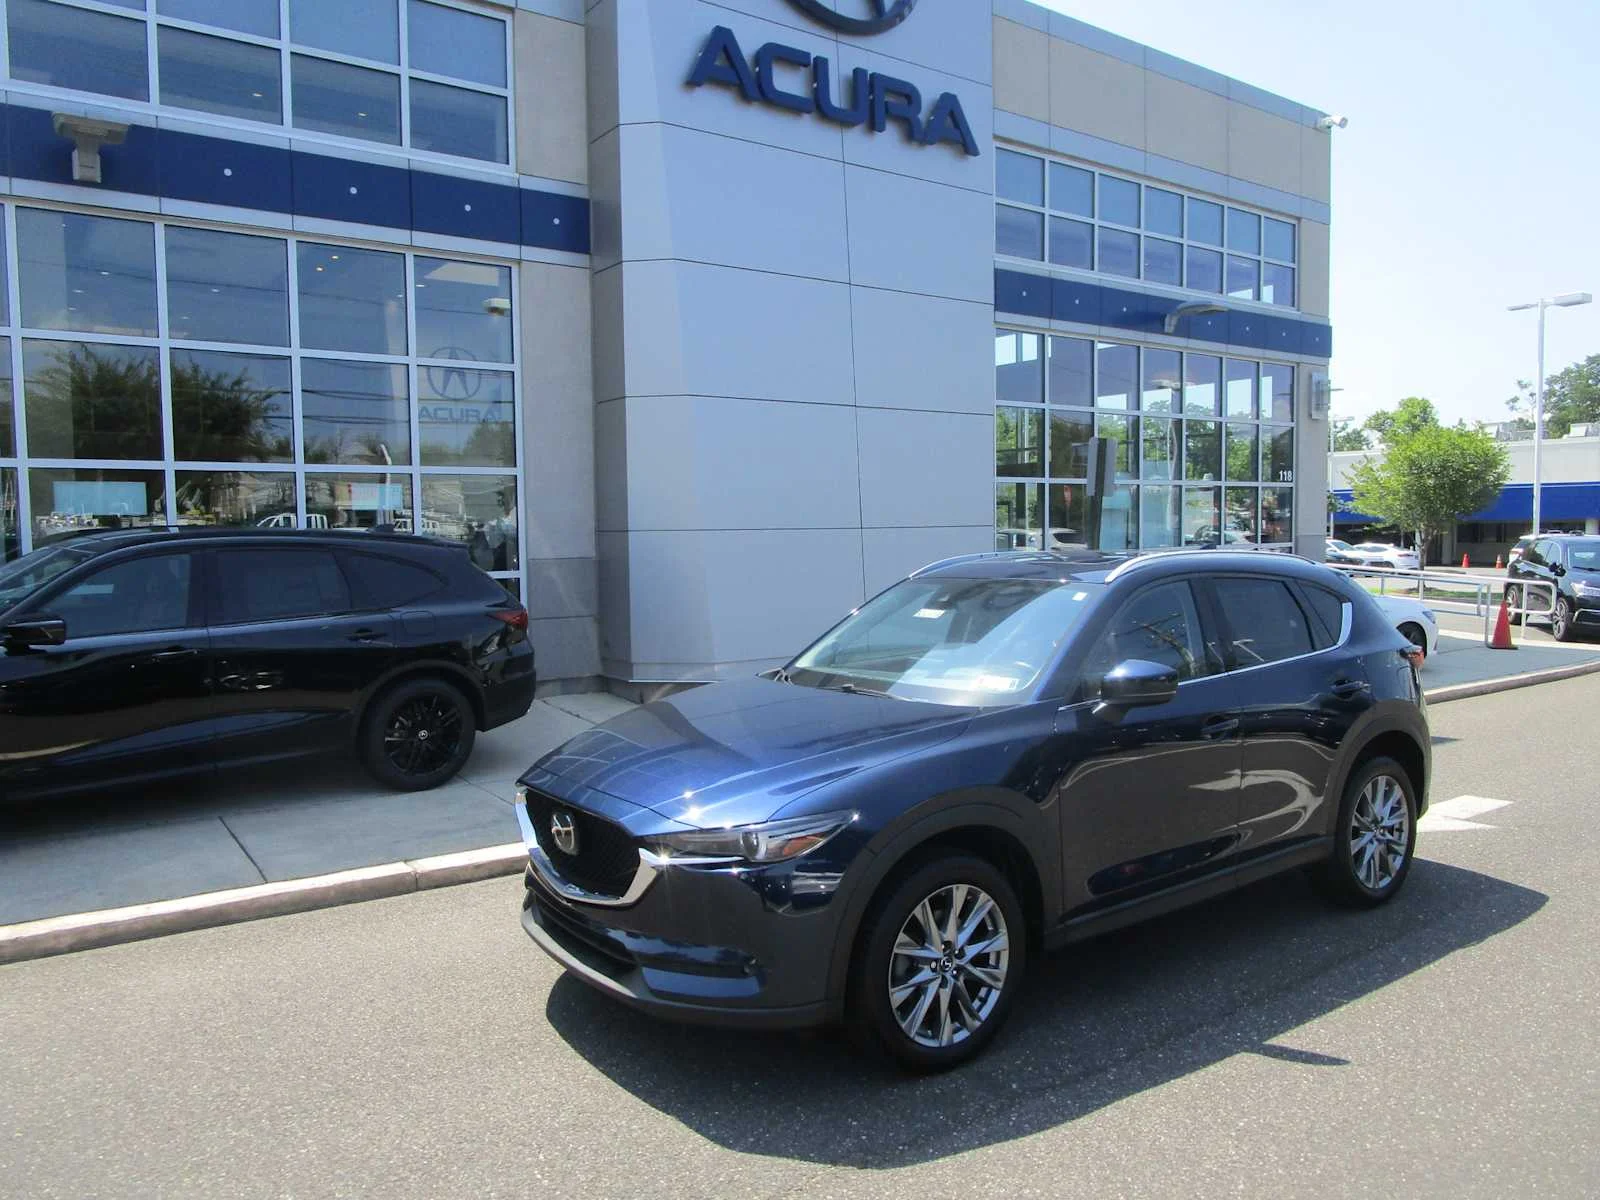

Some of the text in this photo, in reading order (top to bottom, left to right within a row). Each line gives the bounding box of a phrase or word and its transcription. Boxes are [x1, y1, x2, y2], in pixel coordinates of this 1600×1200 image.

[685, 25, 980, 157] ACURA
[419, 406, 498, 423] ACURA
[1279, 470, 1293, 481] 118
